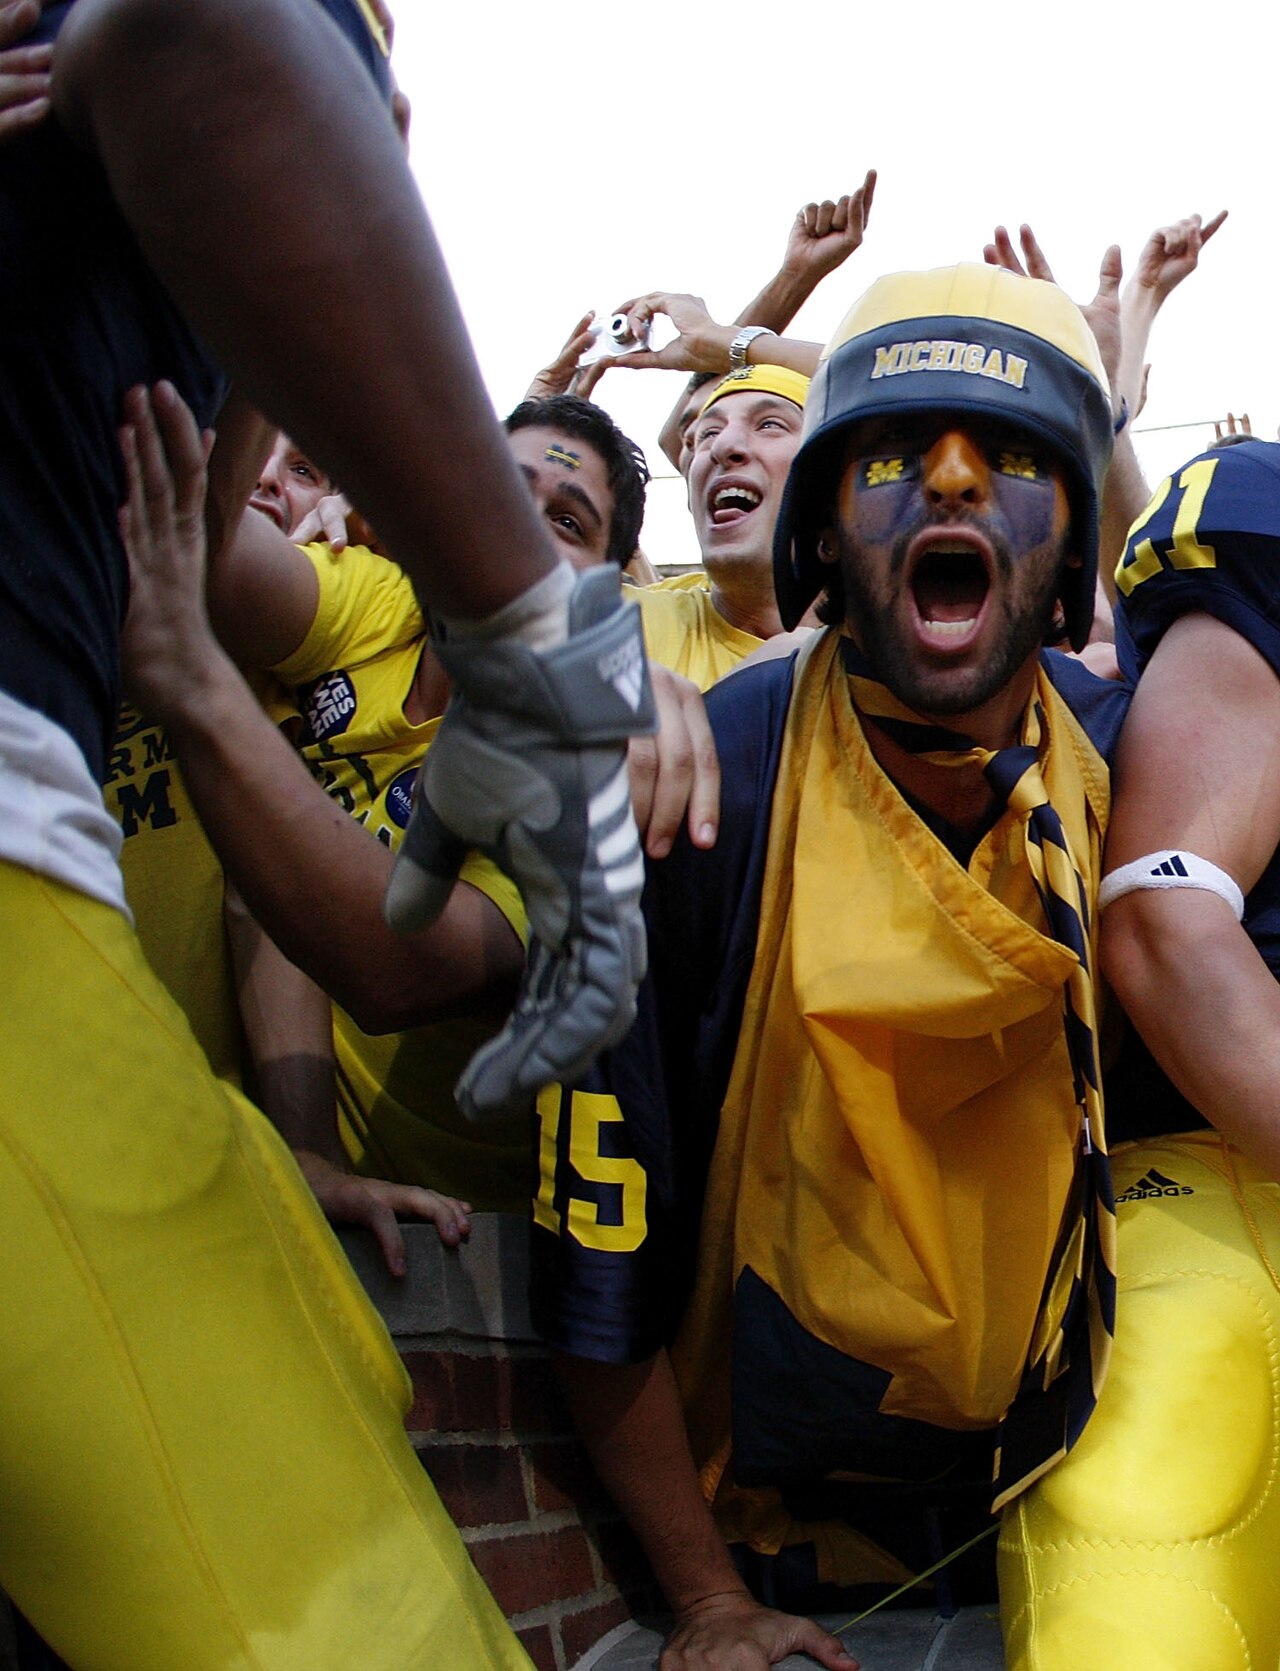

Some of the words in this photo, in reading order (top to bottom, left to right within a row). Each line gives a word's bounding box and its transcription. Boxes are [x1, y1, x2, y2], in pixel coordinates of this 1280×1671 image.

[871, 340, 1028, 388] MICHIGAN
[1114, 458, 1217, 597] 21
[312, 681, 341, 729] WE
[327, 671, 356, 715] YES
[117, 769, 177, 838] M
[532, 1081, 649, 1253] 15
[1114, 1186, 1195, 1203] adidas
